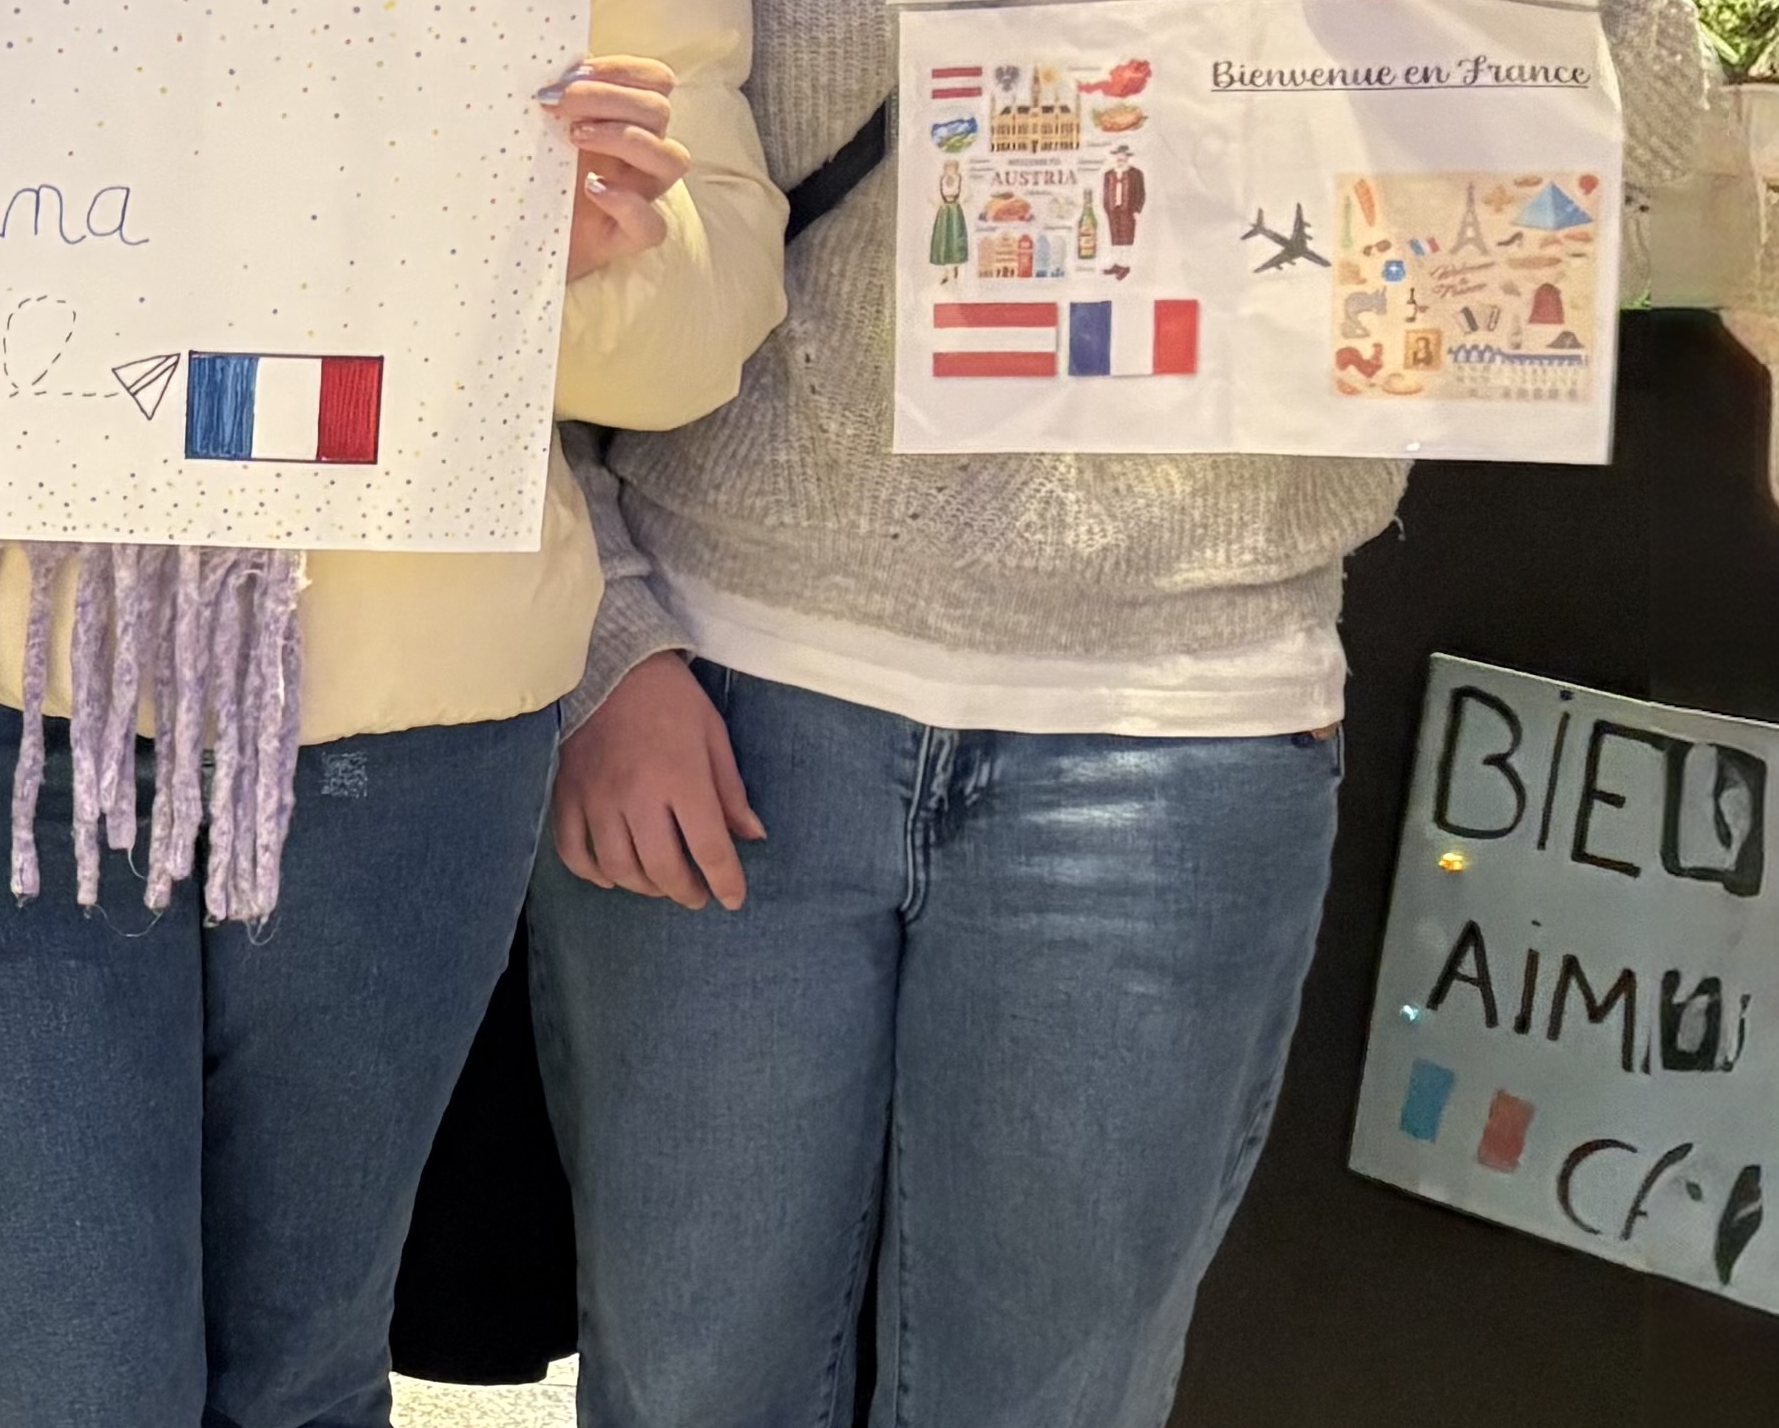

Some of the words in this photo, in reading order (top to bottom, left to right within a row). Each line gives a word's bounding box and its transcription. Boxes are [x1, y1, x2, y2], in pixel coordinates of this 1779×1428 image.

[1211, 59, 1396, 89] Bienvenue
[1405, 62, 1451, 86] en
[1457, 54, 1592, 86] France
[992, 169, 1078, 187] AUSTRIA
